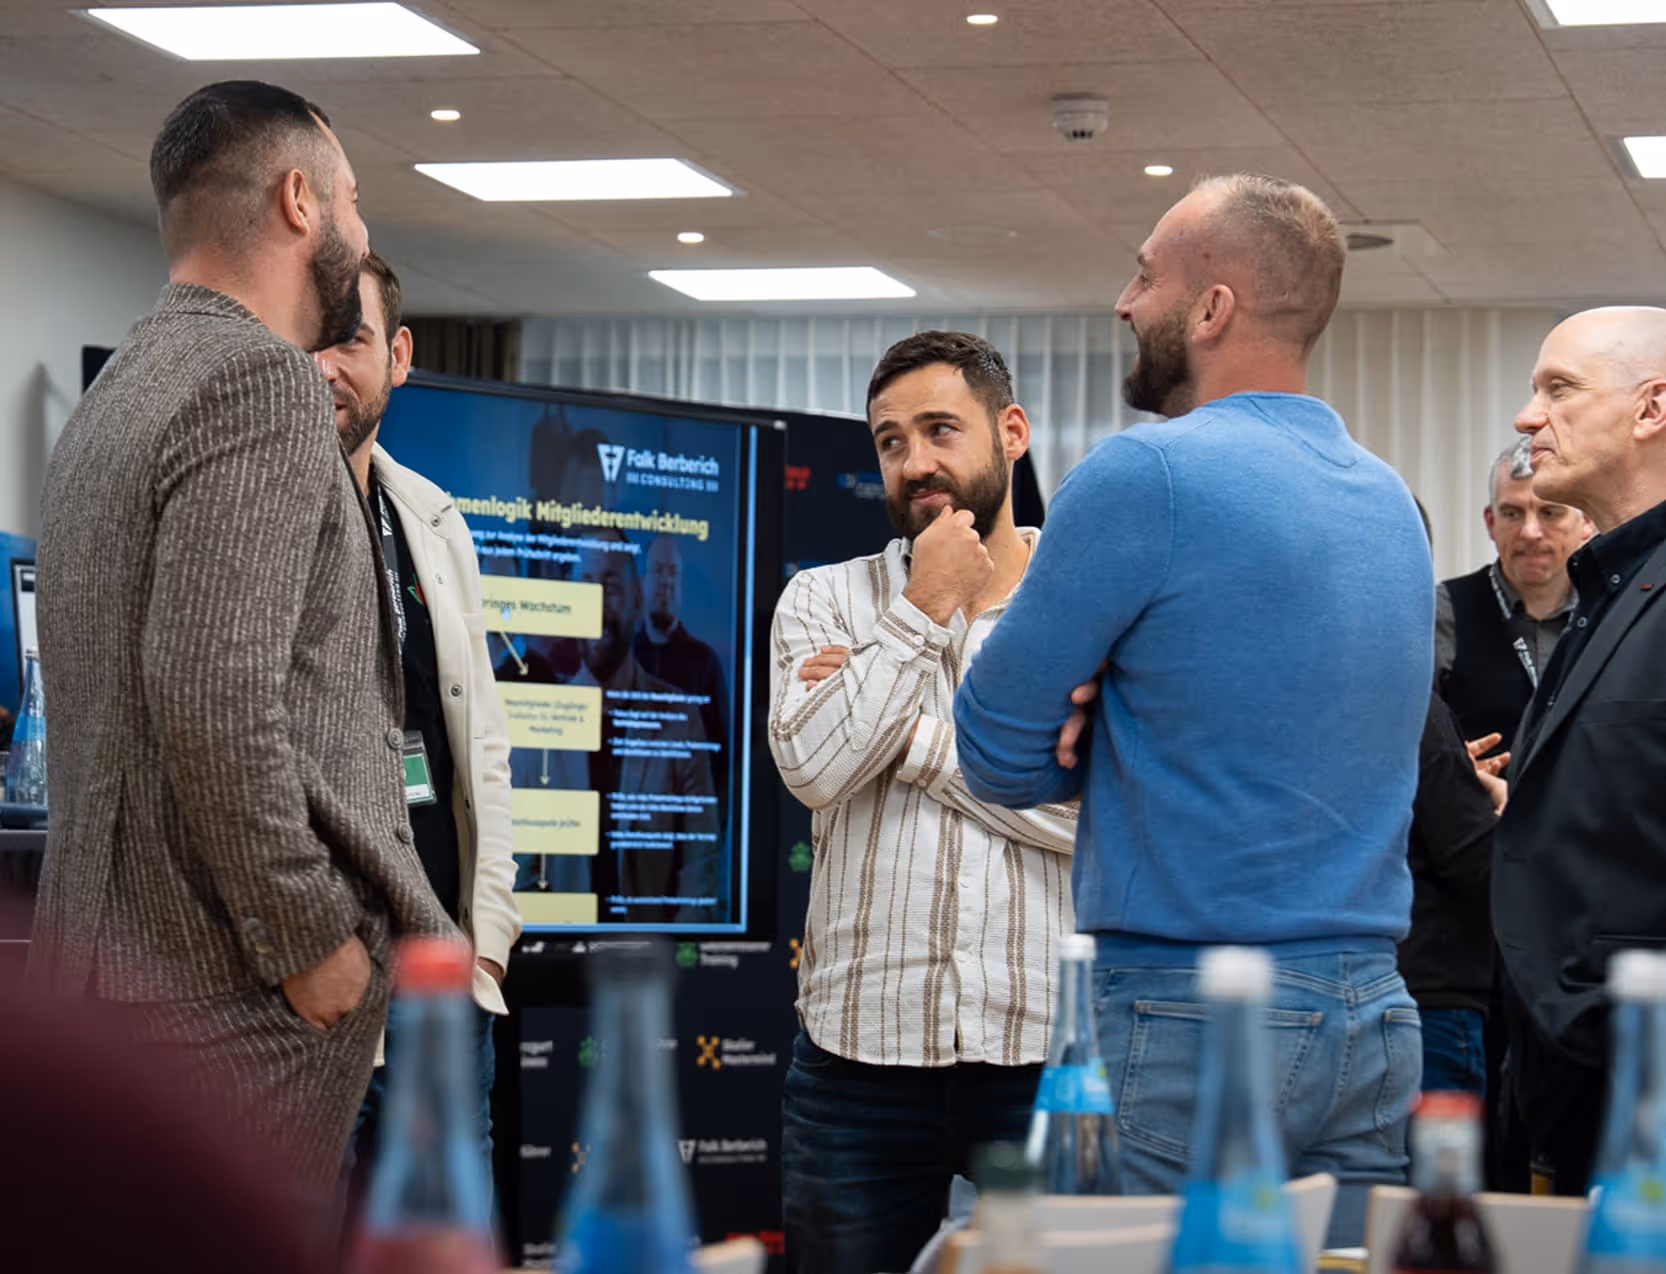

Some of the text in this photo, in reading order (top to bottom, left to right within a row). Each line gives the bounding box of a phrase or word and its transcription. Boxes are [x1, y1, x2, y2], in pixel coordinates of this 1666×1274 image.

[627, 449, 719, 476] Falk Berberich
[640, 473, 705, 492] CONSULTING
[536, 500, 709, 540] Mitgliederentwicklung
[481, 597, 572, 614] ringes Wachstum
